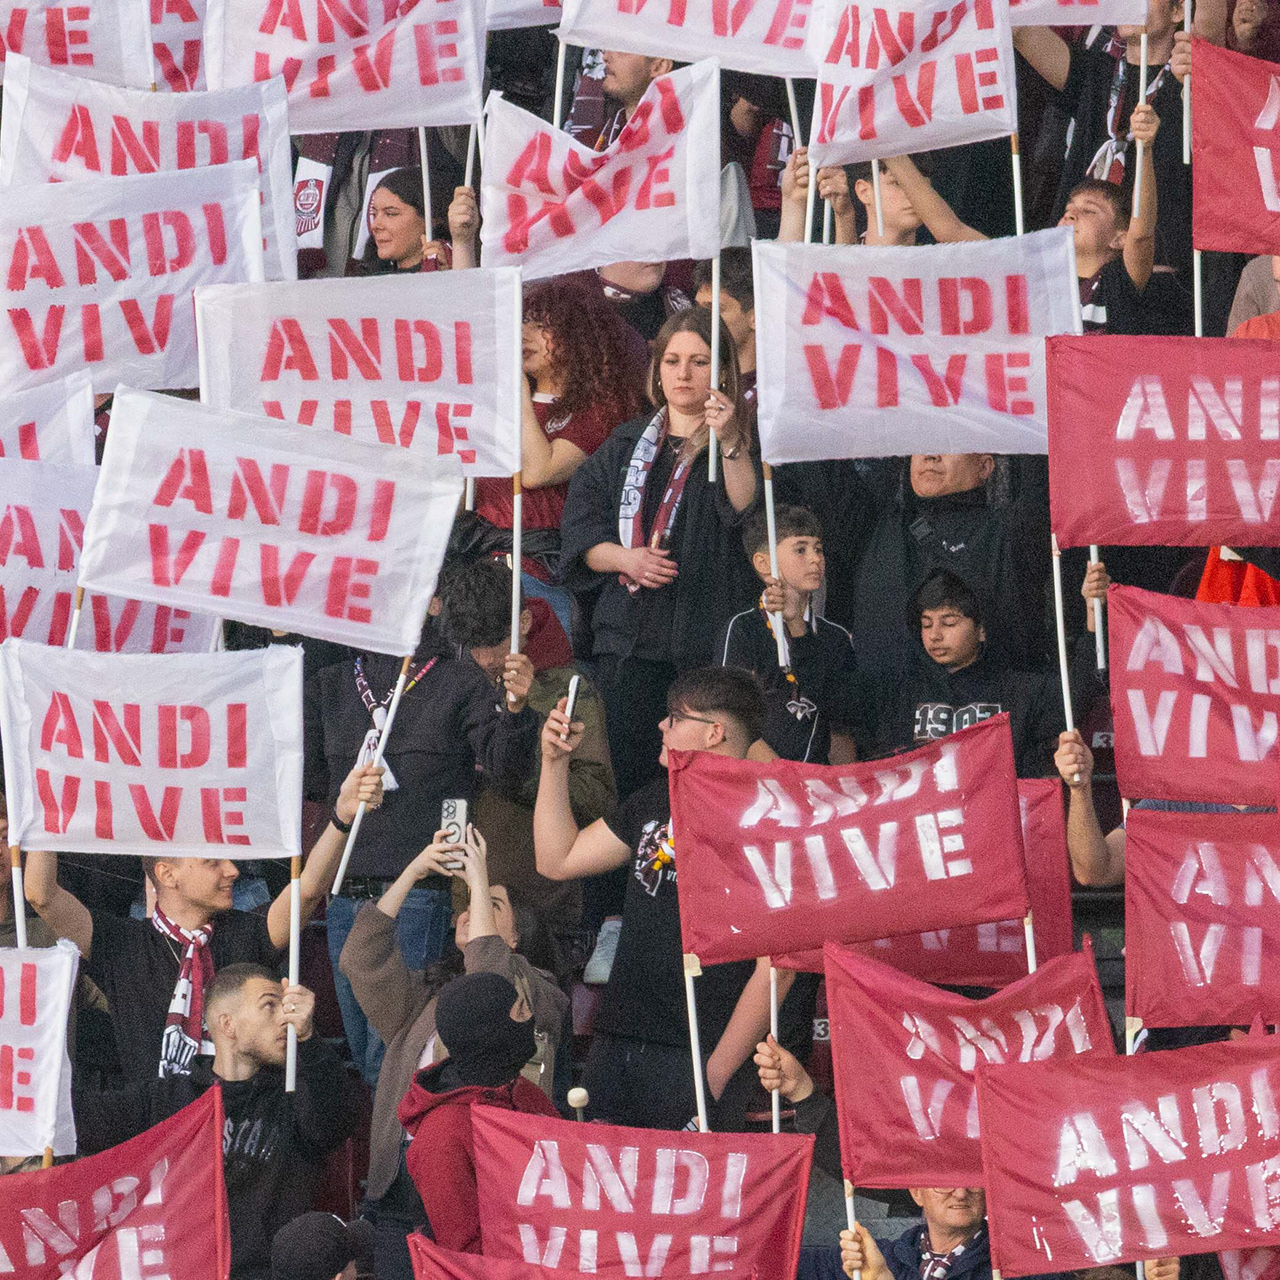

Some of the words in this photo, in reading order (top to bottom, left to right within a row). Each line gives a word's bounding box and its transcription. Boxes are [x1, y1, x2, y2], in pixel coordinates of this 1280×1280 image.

[254, 21, 464, 100] VIVE
[826, 0, 994, 70] ANDI
[820, 50, 1006, 143] VIVE
[53, 104, 259, 175] ANDI
[7, 202, 226, 291] ANDI
[7, 293, 177, 370] VIV
[802, 272, 1030, 336] ANDI
[261, 318, 472, 385] ANDI
[803, 344, 1034, 416] VIVE
[154, 447, 396, 540] ANDI
[148, 523, 379, 623] VIVE
[40, 691, 248, 768] ANDI
[37, 769, 251, 845] VIVE
[740, 743, 960, 829] ANDI
[743, 808, 973, 909] VIVE
[1054, 1068, 1280, 1186] ANDI
[517, 1140, 747, 1219] ANDI
